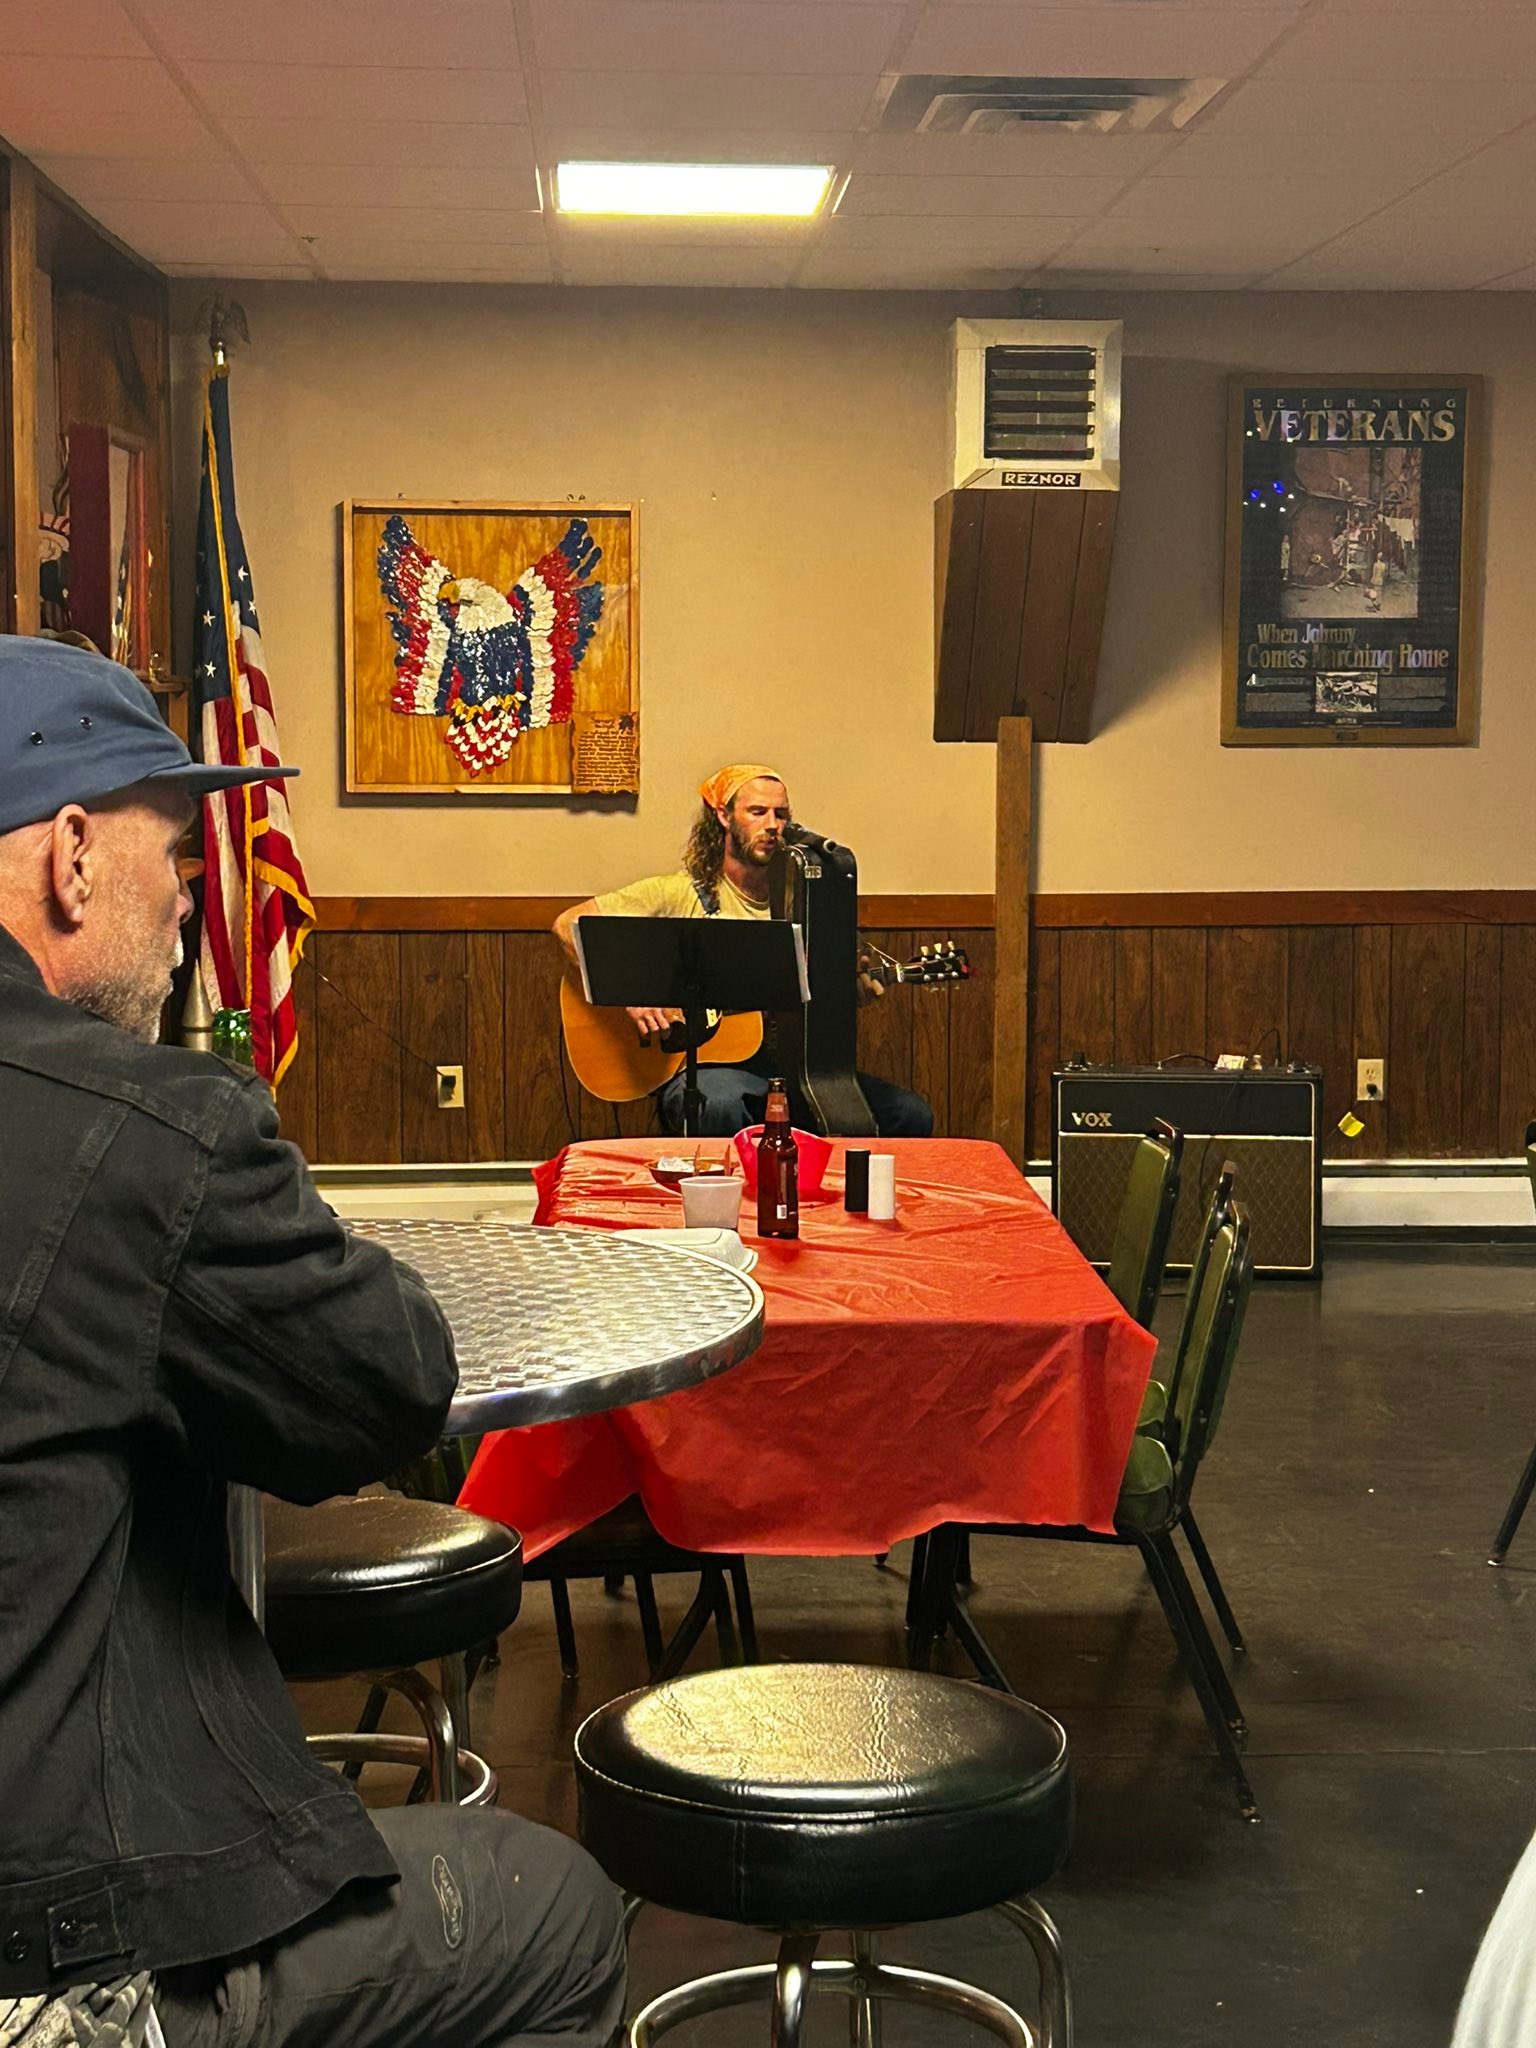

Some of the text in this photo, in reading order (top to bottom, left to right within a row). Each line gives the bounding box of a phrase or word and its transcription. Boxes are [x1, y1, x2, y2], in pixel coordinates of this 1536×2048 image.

[1254, 410, 1455, 441] VETERANS
[1005, 473, 1076, 485] REZNOR
[1257, 623, 1357, 645] When Johnny
[1247, 642, 1449, 674] Comes Marching Home
[1071, 1112, 1112, 1127] VOX
